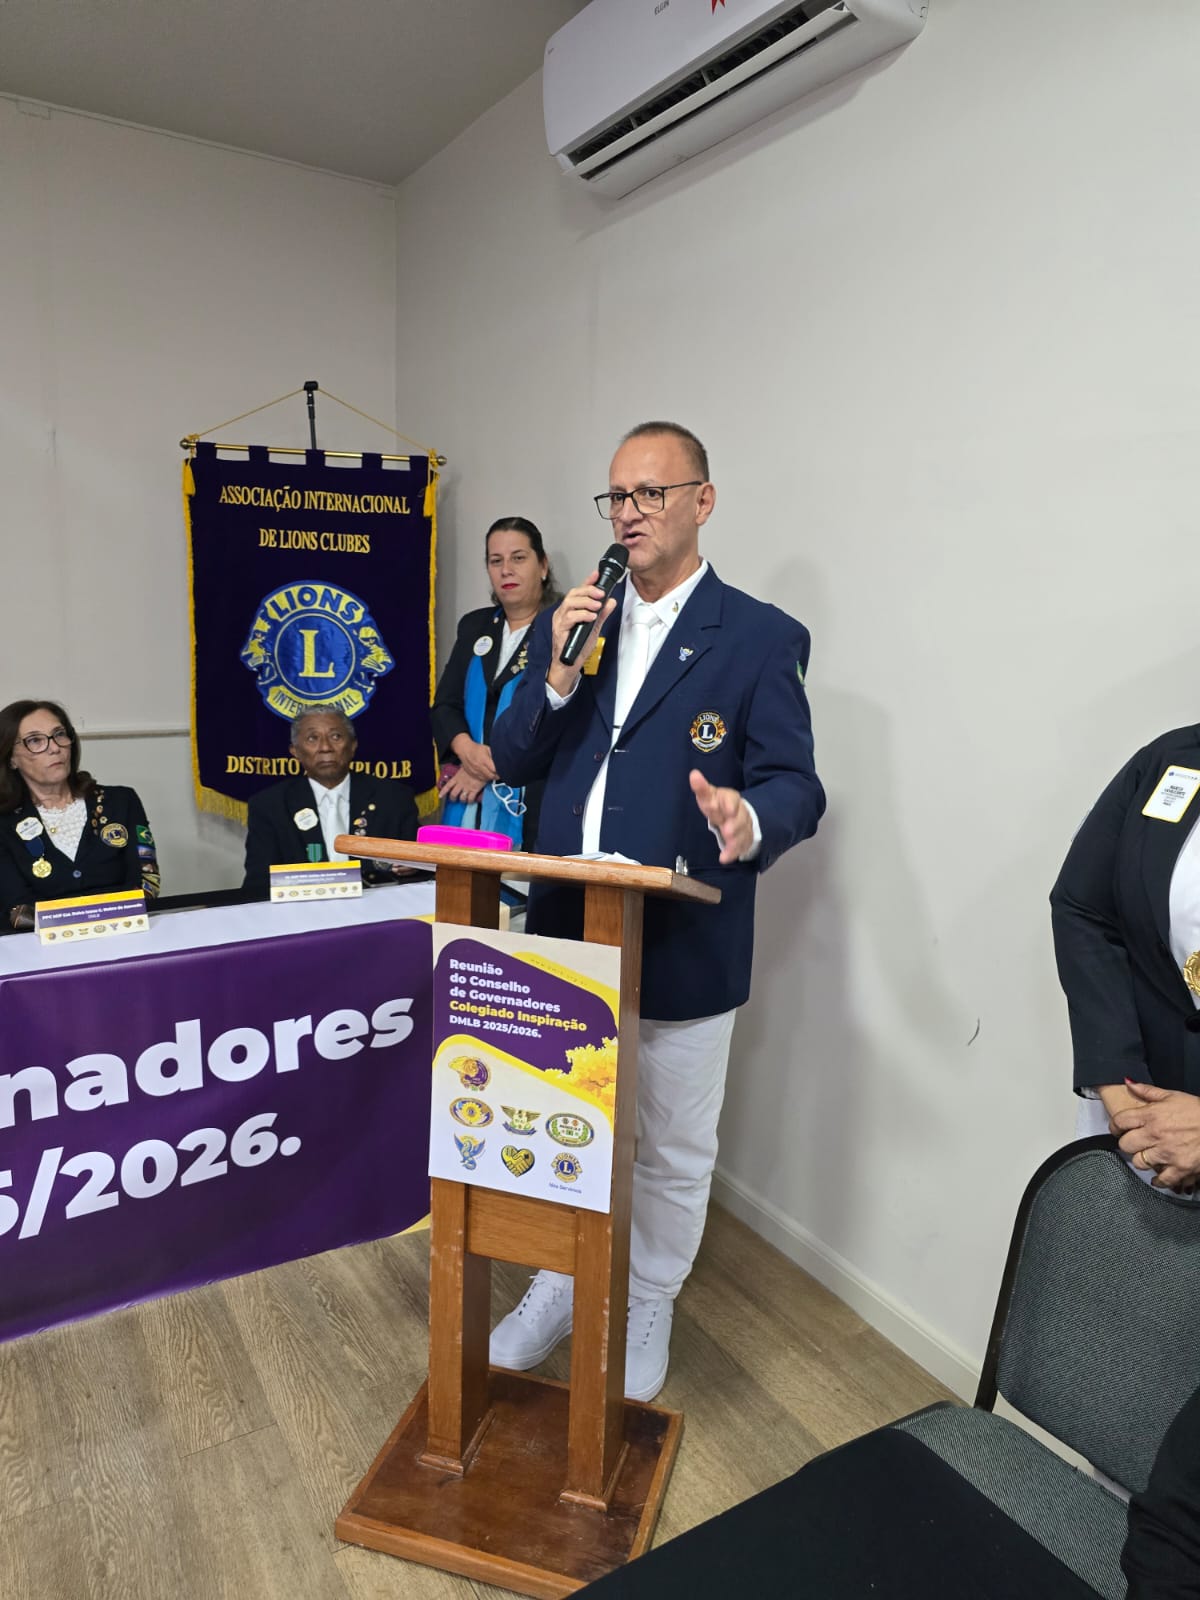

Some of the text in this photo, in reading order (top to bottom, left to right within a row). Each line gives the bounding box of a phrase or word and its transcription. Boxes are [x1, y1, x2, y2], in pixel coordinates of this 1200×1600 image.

[219, 485, 411, 515] ASSOCIAÇÃO INTERNACIONAL
[259, 528, 371, 553] DE LIONS CLUBES
[269, 586, 361, 621] LIONS
[298, 629, 335, 678] L
[701, 724, 713, 739] L
[225, 755, 300, 775] DISTRITO
[449, 959, 503, 976] Reunião
[449, 973, 531, 994] do Conselho
[449, 986, 561, 1013] de Governadores
[449, 1000, 587, 1032] Colegiado Inspiração
[449, 1014, 542, 1038] DMLB 2025/2026.
[563, 1161, 571, 1173] L
